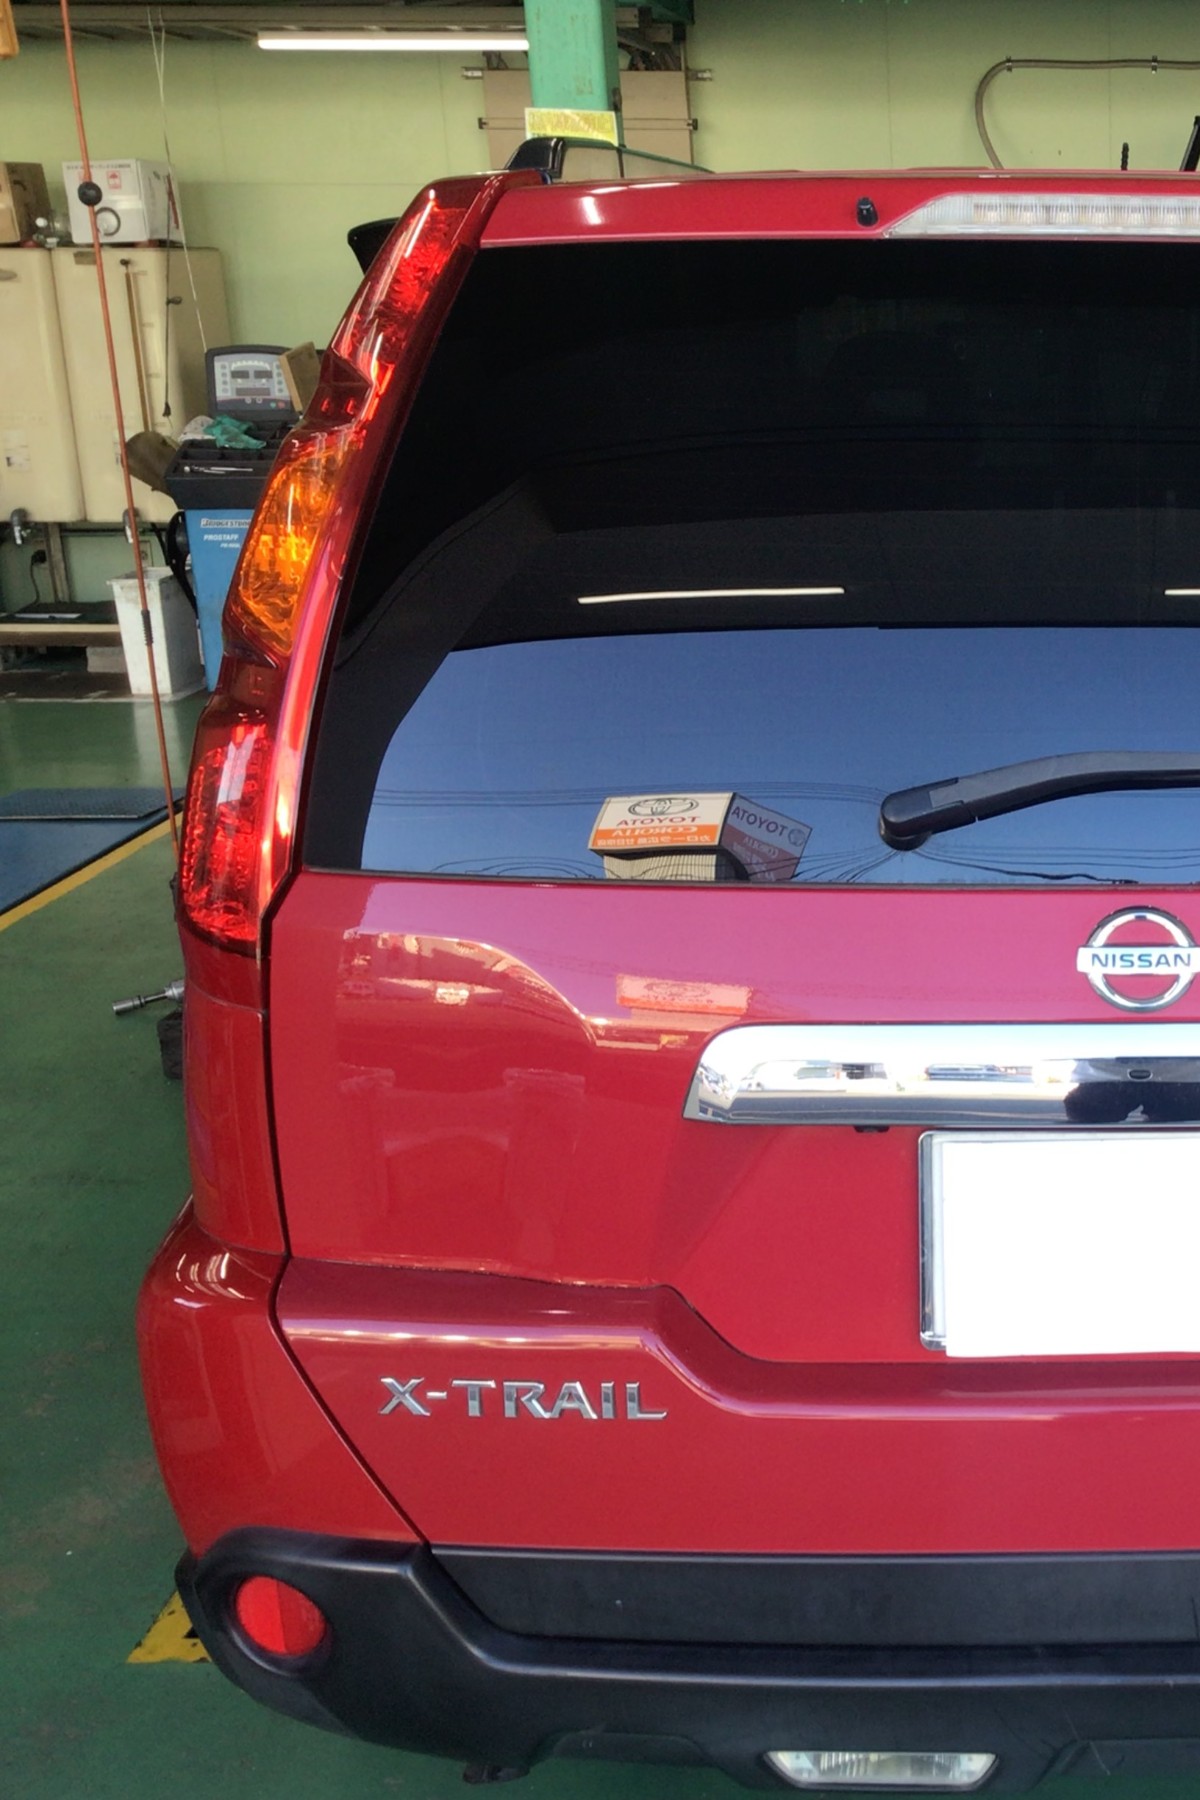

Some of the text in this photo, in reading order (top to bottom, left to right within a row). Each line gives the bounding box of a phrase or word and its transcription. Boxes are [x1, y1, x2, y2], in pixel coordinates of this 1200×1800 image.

[203, 518, 250, 527] BRIDGESTON
[1091, 953, 1191, 968] NISSAN
[377, 1376, 668, 1420] X-TRAIL
